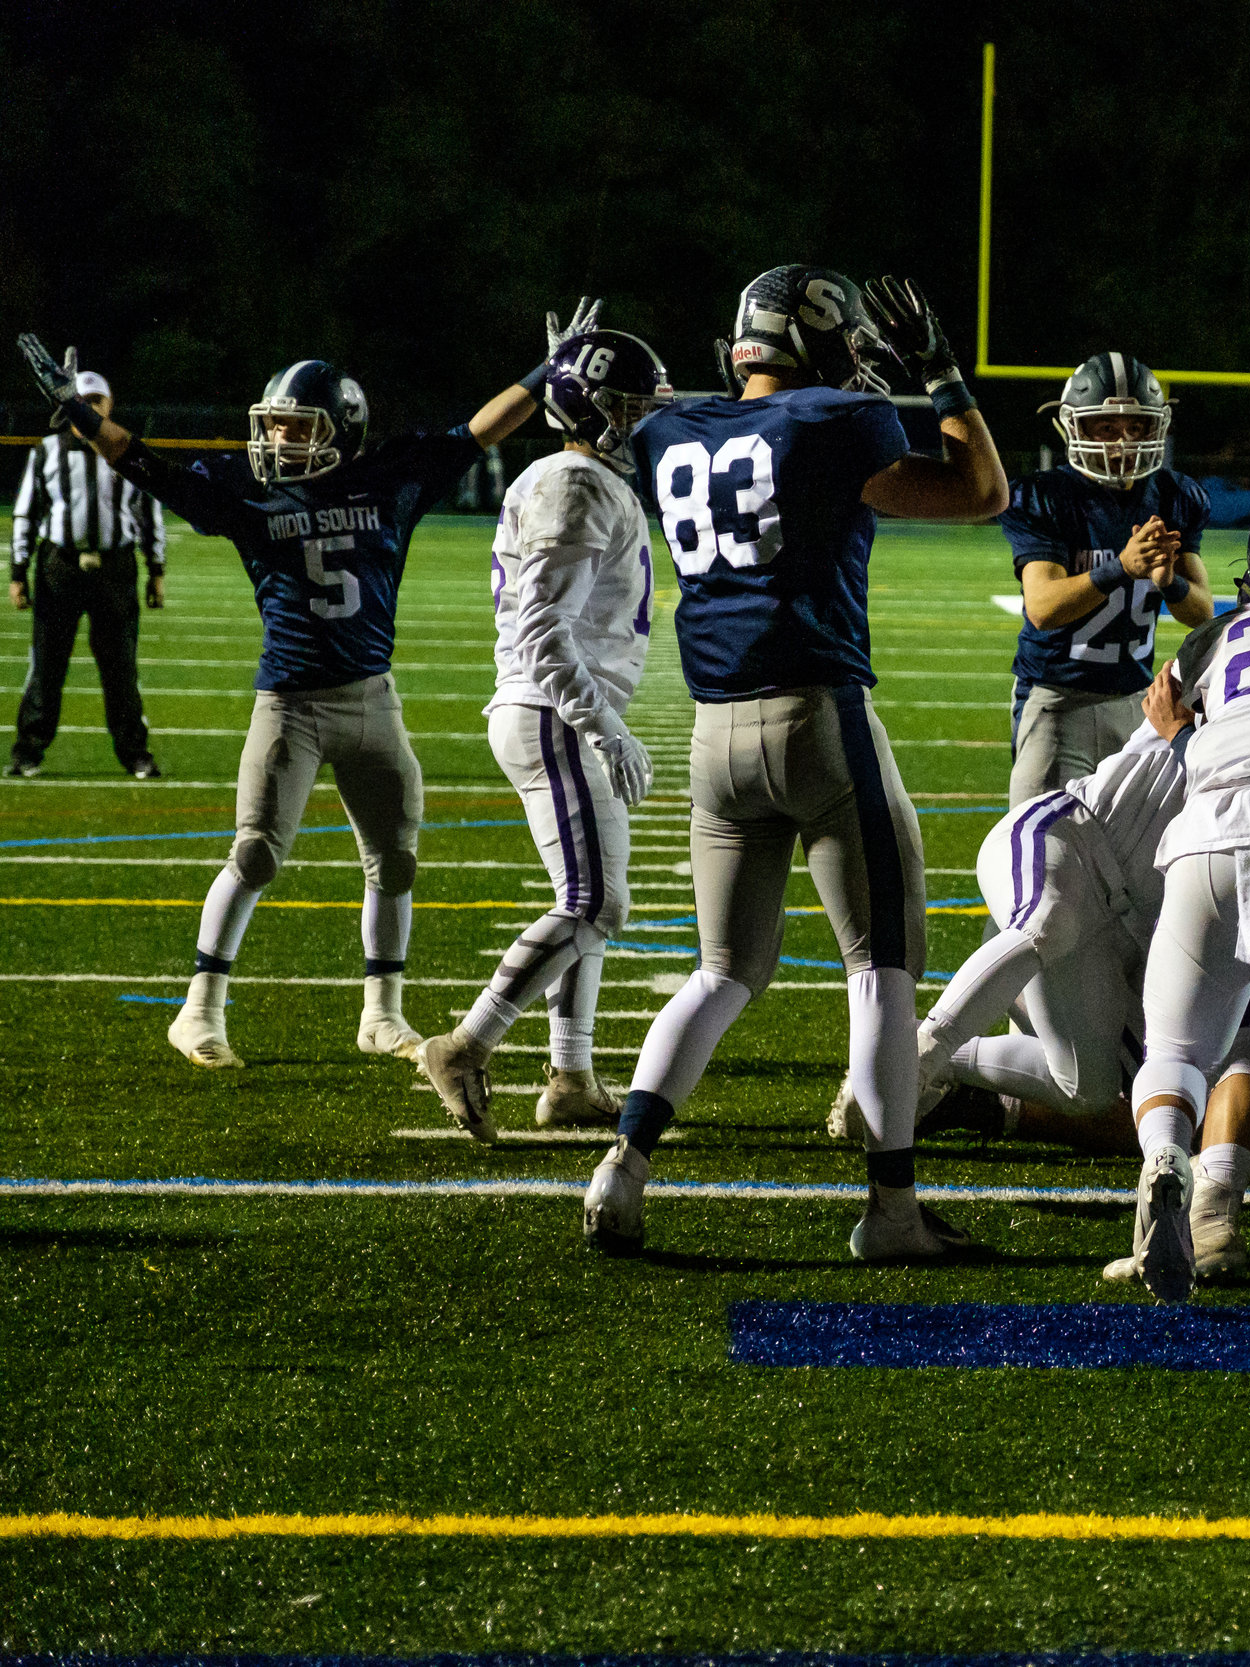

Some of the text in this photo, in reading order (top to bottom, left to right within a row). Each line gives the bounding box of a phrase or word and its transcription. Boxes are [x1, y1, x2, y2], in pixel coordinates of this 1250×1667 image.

[799, 278, 846, 332] S
[570, 343, 615, 380] 16
[732, 345, 762, 361] ddell
[266, 505, 381, 541] MIDD SOUTH
[656, 433, 784, 577] 83
[303, 533, 361, 620] 5
[1068, 578, 1156, 664] 25
